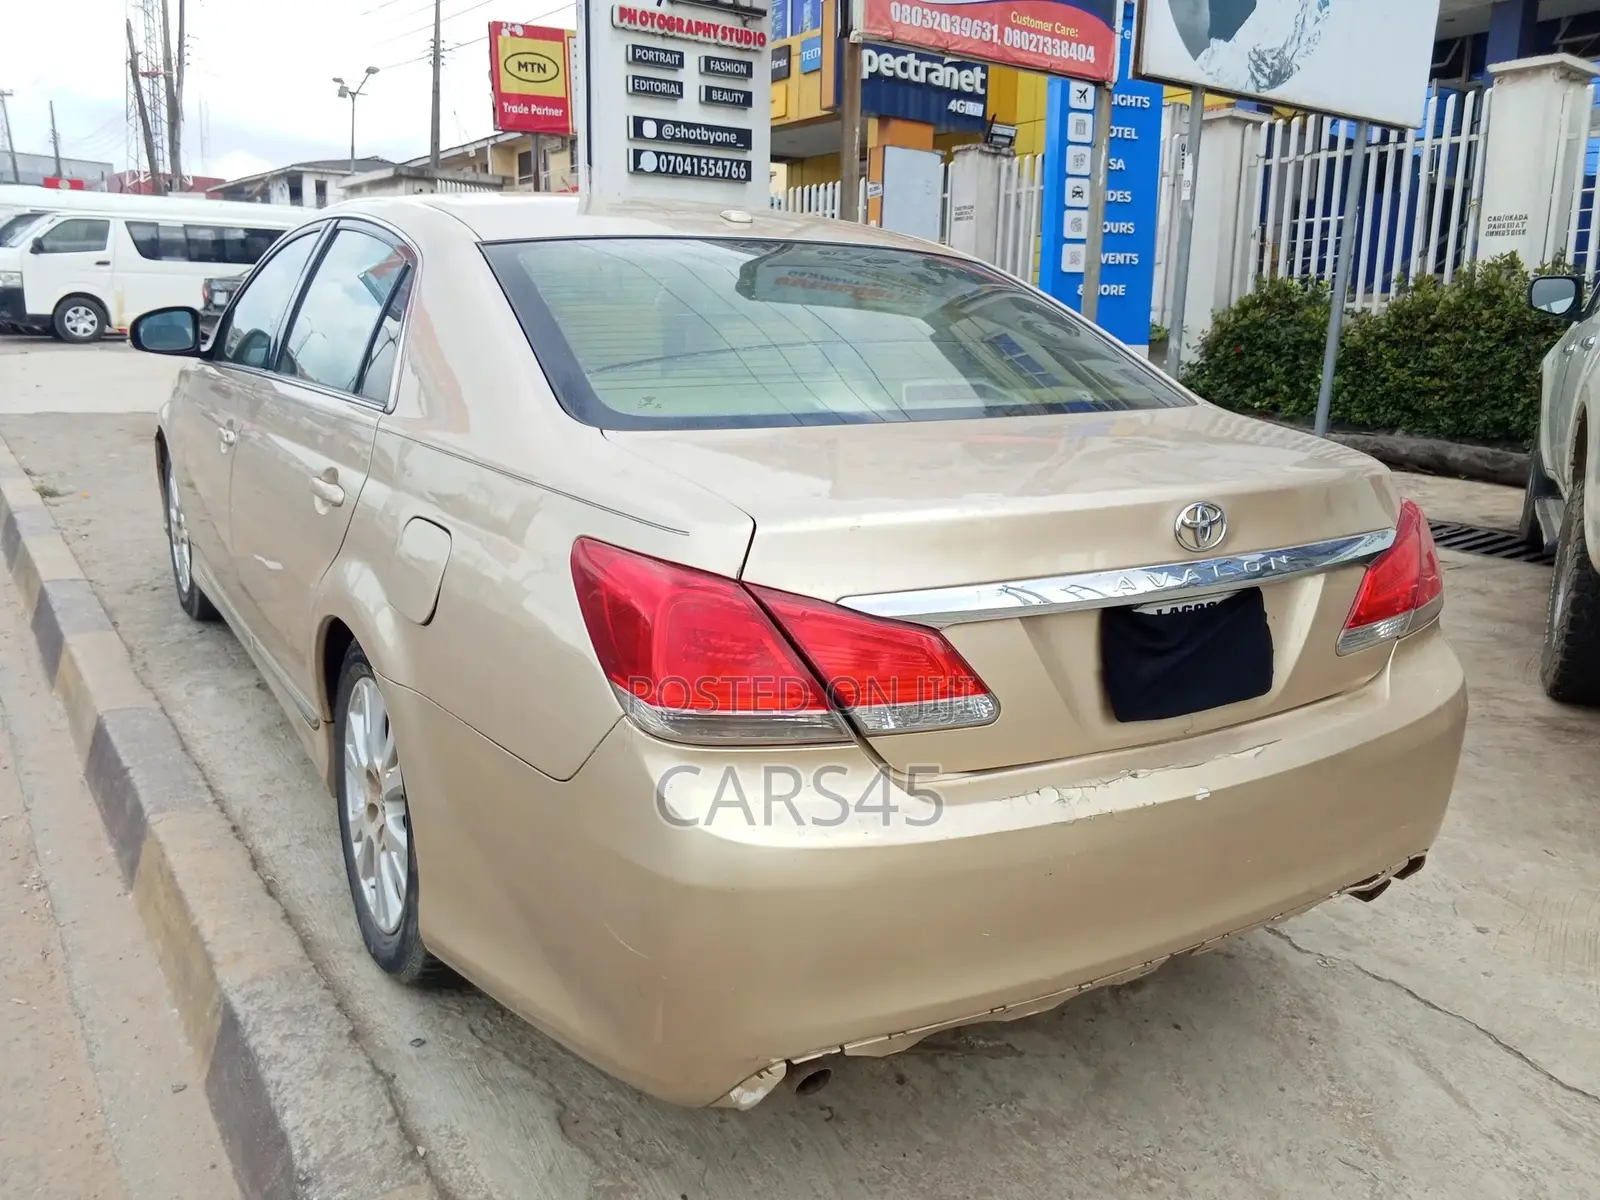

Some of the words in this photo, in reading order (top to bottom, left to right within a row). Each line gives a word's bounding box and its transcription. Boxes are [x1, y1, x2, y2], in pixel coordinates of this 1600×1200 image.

[618, 6, 720, 40] PHOTOGRAPHY
[720, 25, 767, 47] STUDIO
[890, 1, 1002, 46] 08032039631,
[1004, 28, 1095, 63] 08027338404
[1010, 11, 1053, 33] Customer
[1054, 23, 1079, 38] Care:
[635, 48, 681, 66] PORTRAIT
[801, 47, 821, 61] TECN
[517, 60, 546, 74] MTN
[709, 60, 748, 75] FASHION
[860, 48, 986, 95] pectranet
[634, 78, 681, 95] EDITORIAL
[711, 90, 745, 104] BEAUTY
[1111, 93, 1151, 109] IGHTS
[502, 102, 528, 115] Trade
[530, 104, 563, 117] Partner
[947, 99, 966, 114] 4G
[661, 124, 745, 147] @shotbyone_
[1109, 125, 1139, 140] OTEL
[658, 155, 747, 180] 07041554766
[1108, 157, 1126, 171] SA
[1105, 190, 1132, 203] DES
[1487, 214, 1528, 222] CAR/OKADA
[1102, 221, 1135, 234] OURS
[1100, 252, 1139, 265] VENTS
[1097, 283, 1127, 296] ORE
[1113, 553, 1291, 593] AVALON
